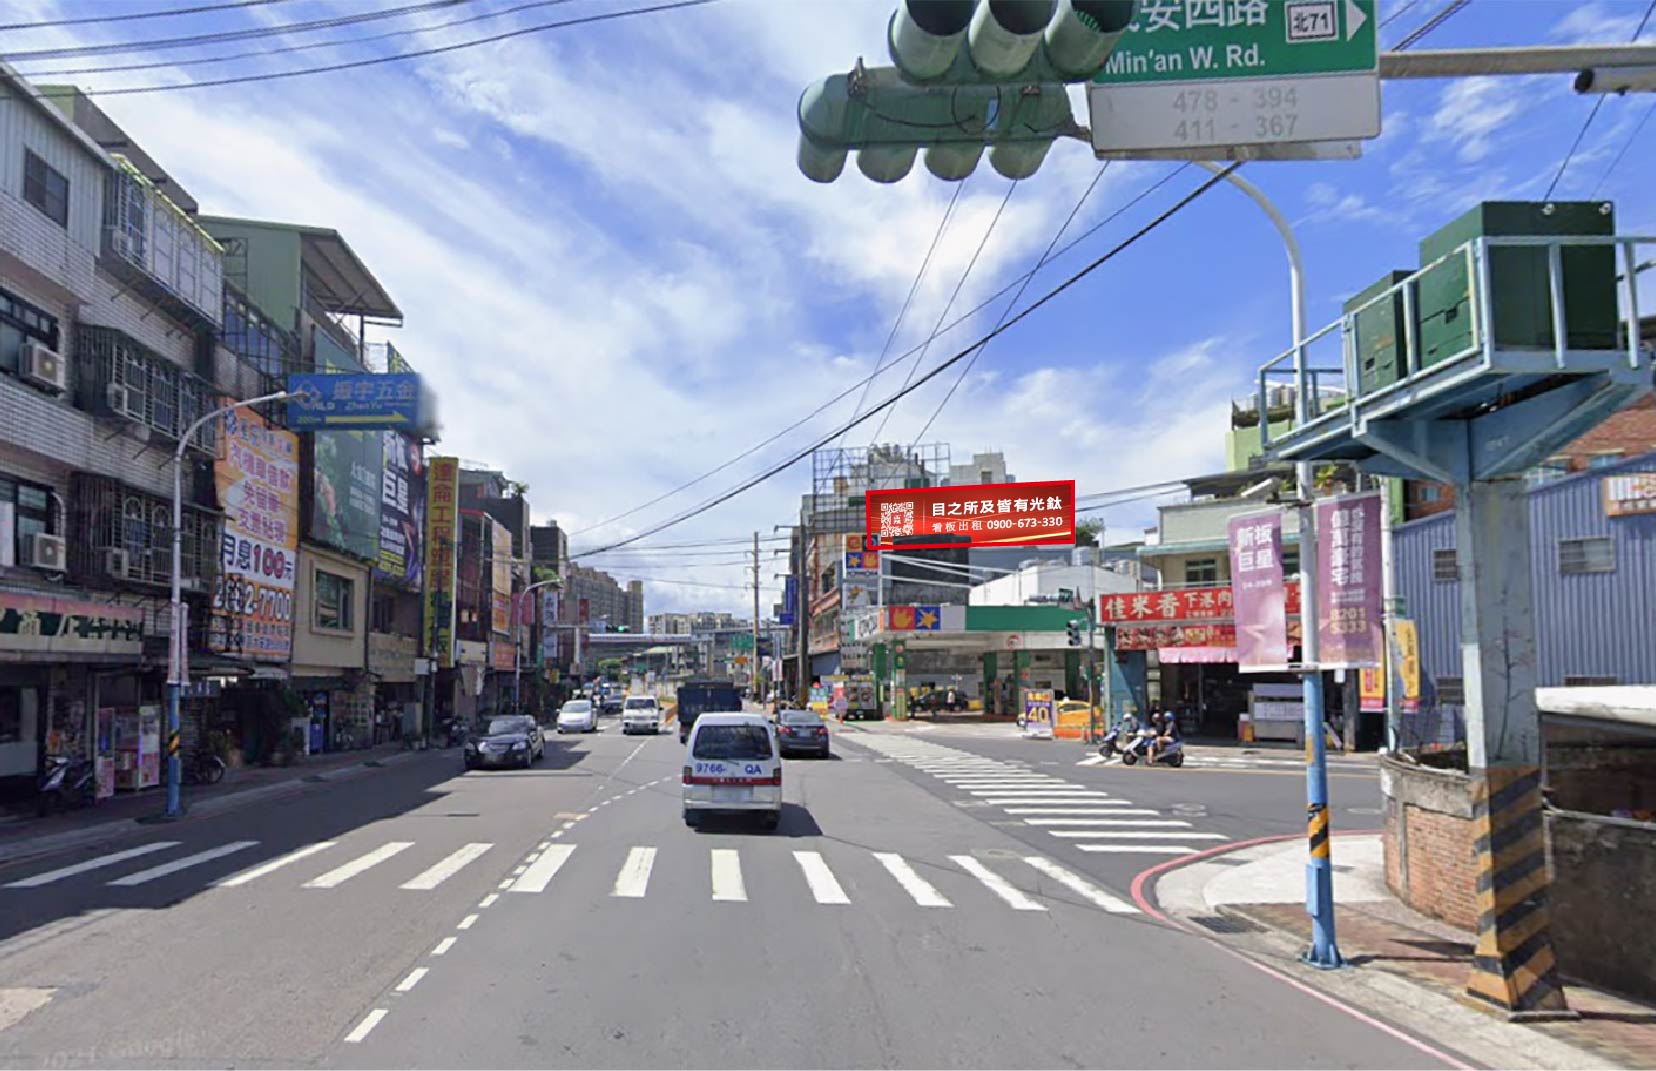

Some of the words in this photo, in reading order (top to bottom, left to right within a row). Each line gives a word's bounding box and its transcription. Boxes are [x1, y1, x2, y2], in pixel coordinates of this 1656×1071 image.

[1128, 0, 1268, 32] 安西路
[1293, 12, 1329, 33] 北71
[1105, 49, 1182, 75] Min'an
[1190, 47, 1219, 69] W.
[1226, 44, 1266, 68] Rd.
[1172, 89, 1218, 113] 478
[1253, 86, 1297, 109] 394
[1173, 119, 1215, 142] 411
[1255, 114, 1298, 138] 367
[931, 496, 1063, 517] 目之所及皆有光鈦
[931, 520, 983, 533] 看板出租
[987, 516, 1063, 531] 0900-673-330
[1238, 548, 1275, 572] 巨星
